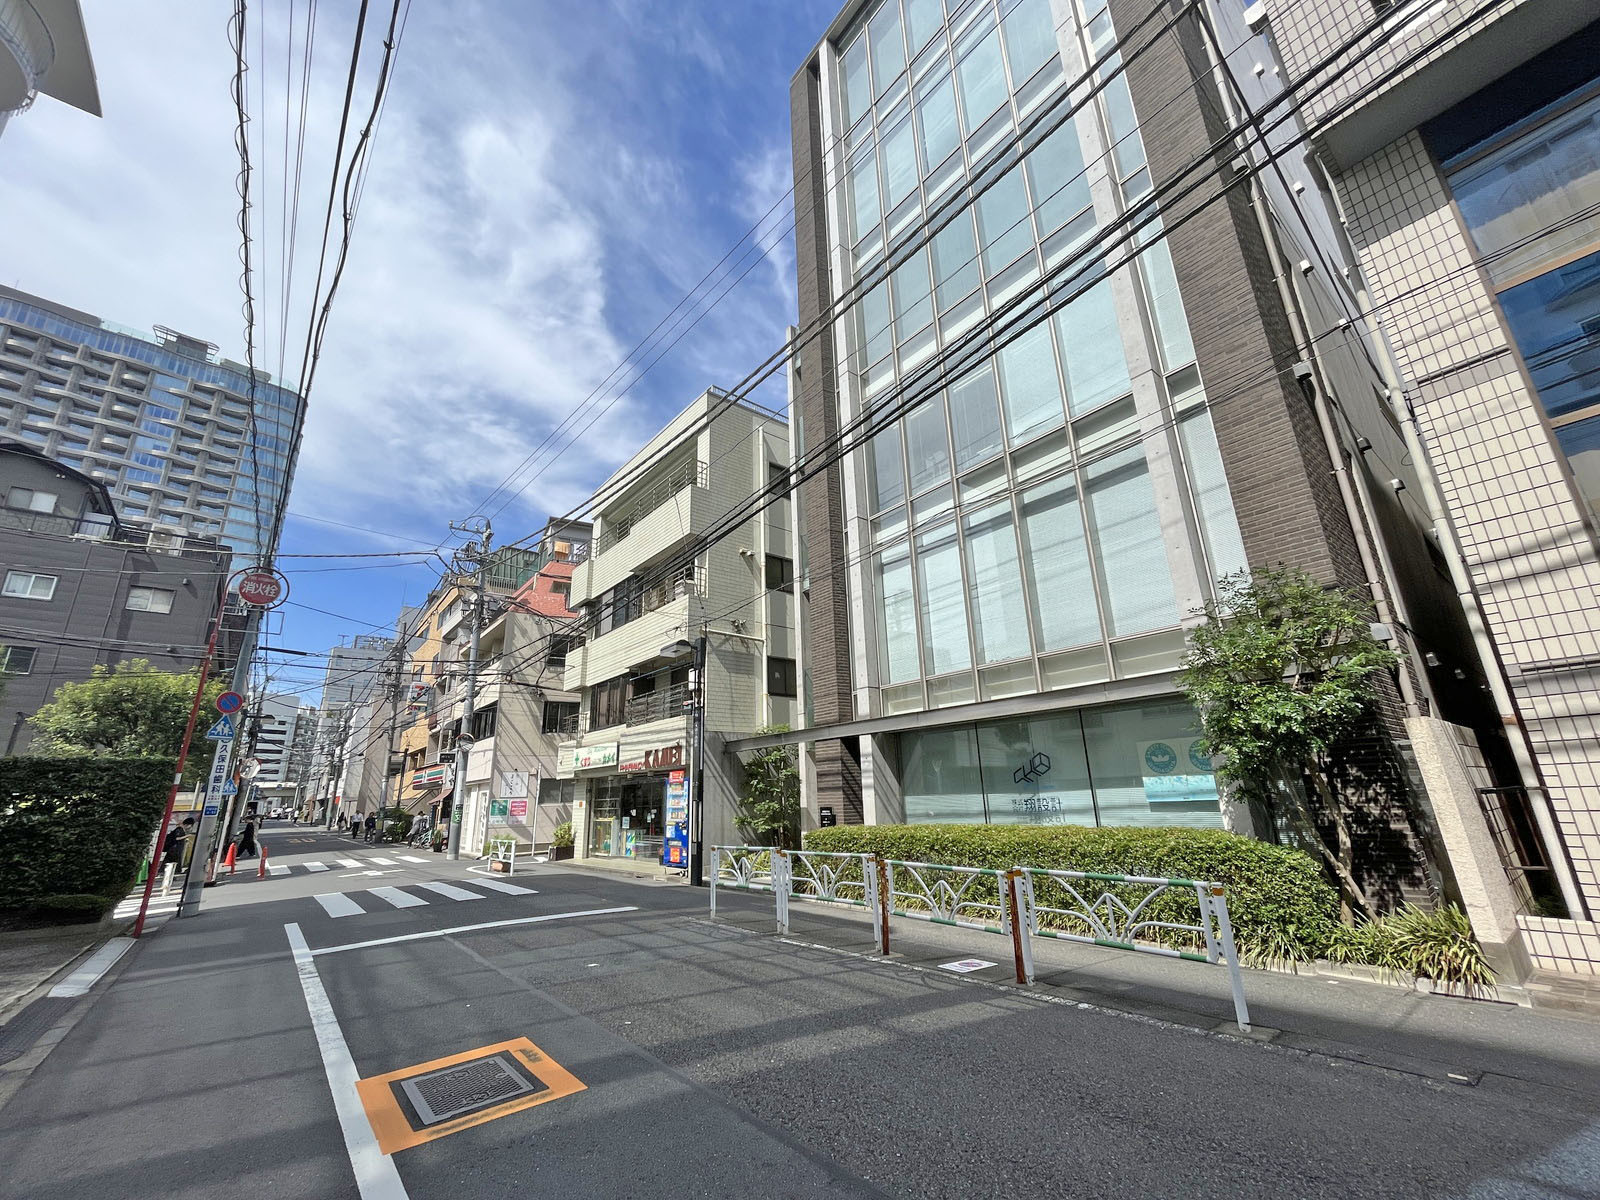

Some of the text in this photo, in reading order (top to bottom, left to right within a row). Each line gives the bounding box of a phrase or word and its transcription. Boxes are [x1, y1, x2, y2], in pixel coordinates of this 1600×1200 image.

[242, 581, 279, 598] 消火栓
[211, 744, 229, 795] 久保田歯科
[1024, 797, 1062, 813] 翔設計
